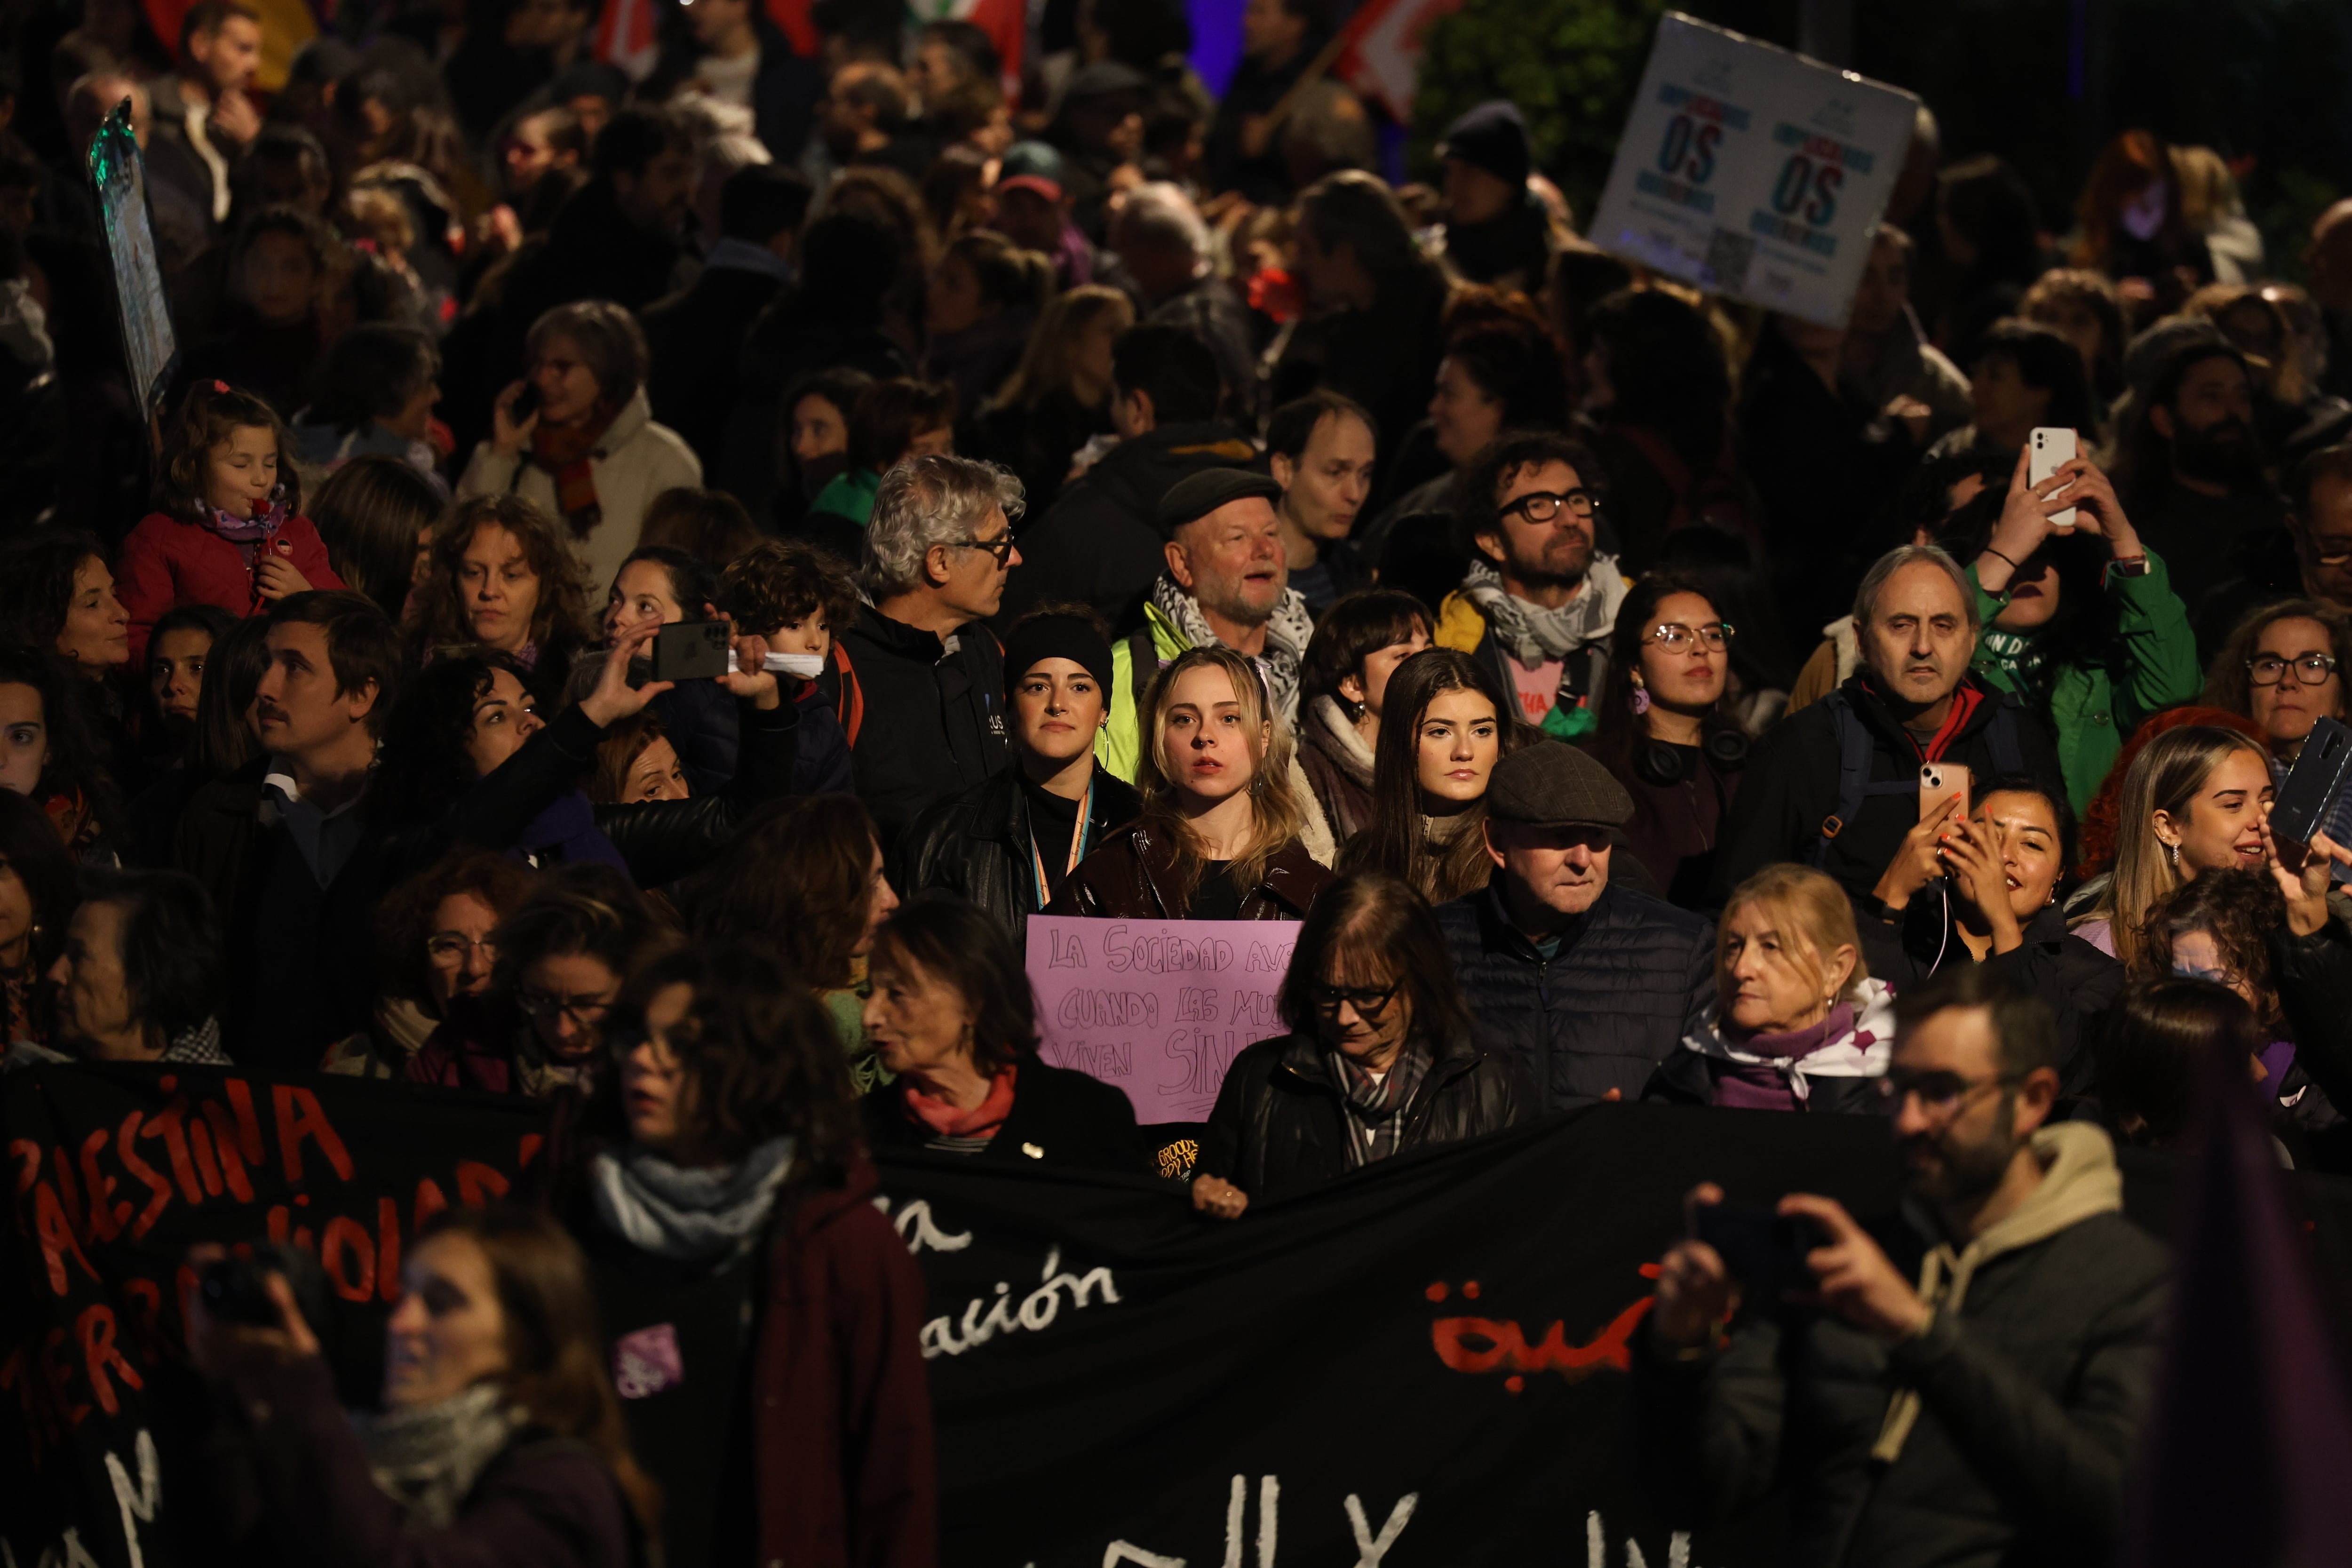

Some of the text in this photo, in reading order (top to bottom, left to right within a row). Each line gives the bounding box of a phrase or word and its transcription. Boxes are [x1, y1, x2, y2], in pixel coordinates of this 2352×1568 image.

[1049, 928, 1087, 969] LA
[1058, 987, 1158, 1030] CUANDO
[1175, 987, 1218, 1022] LAS
